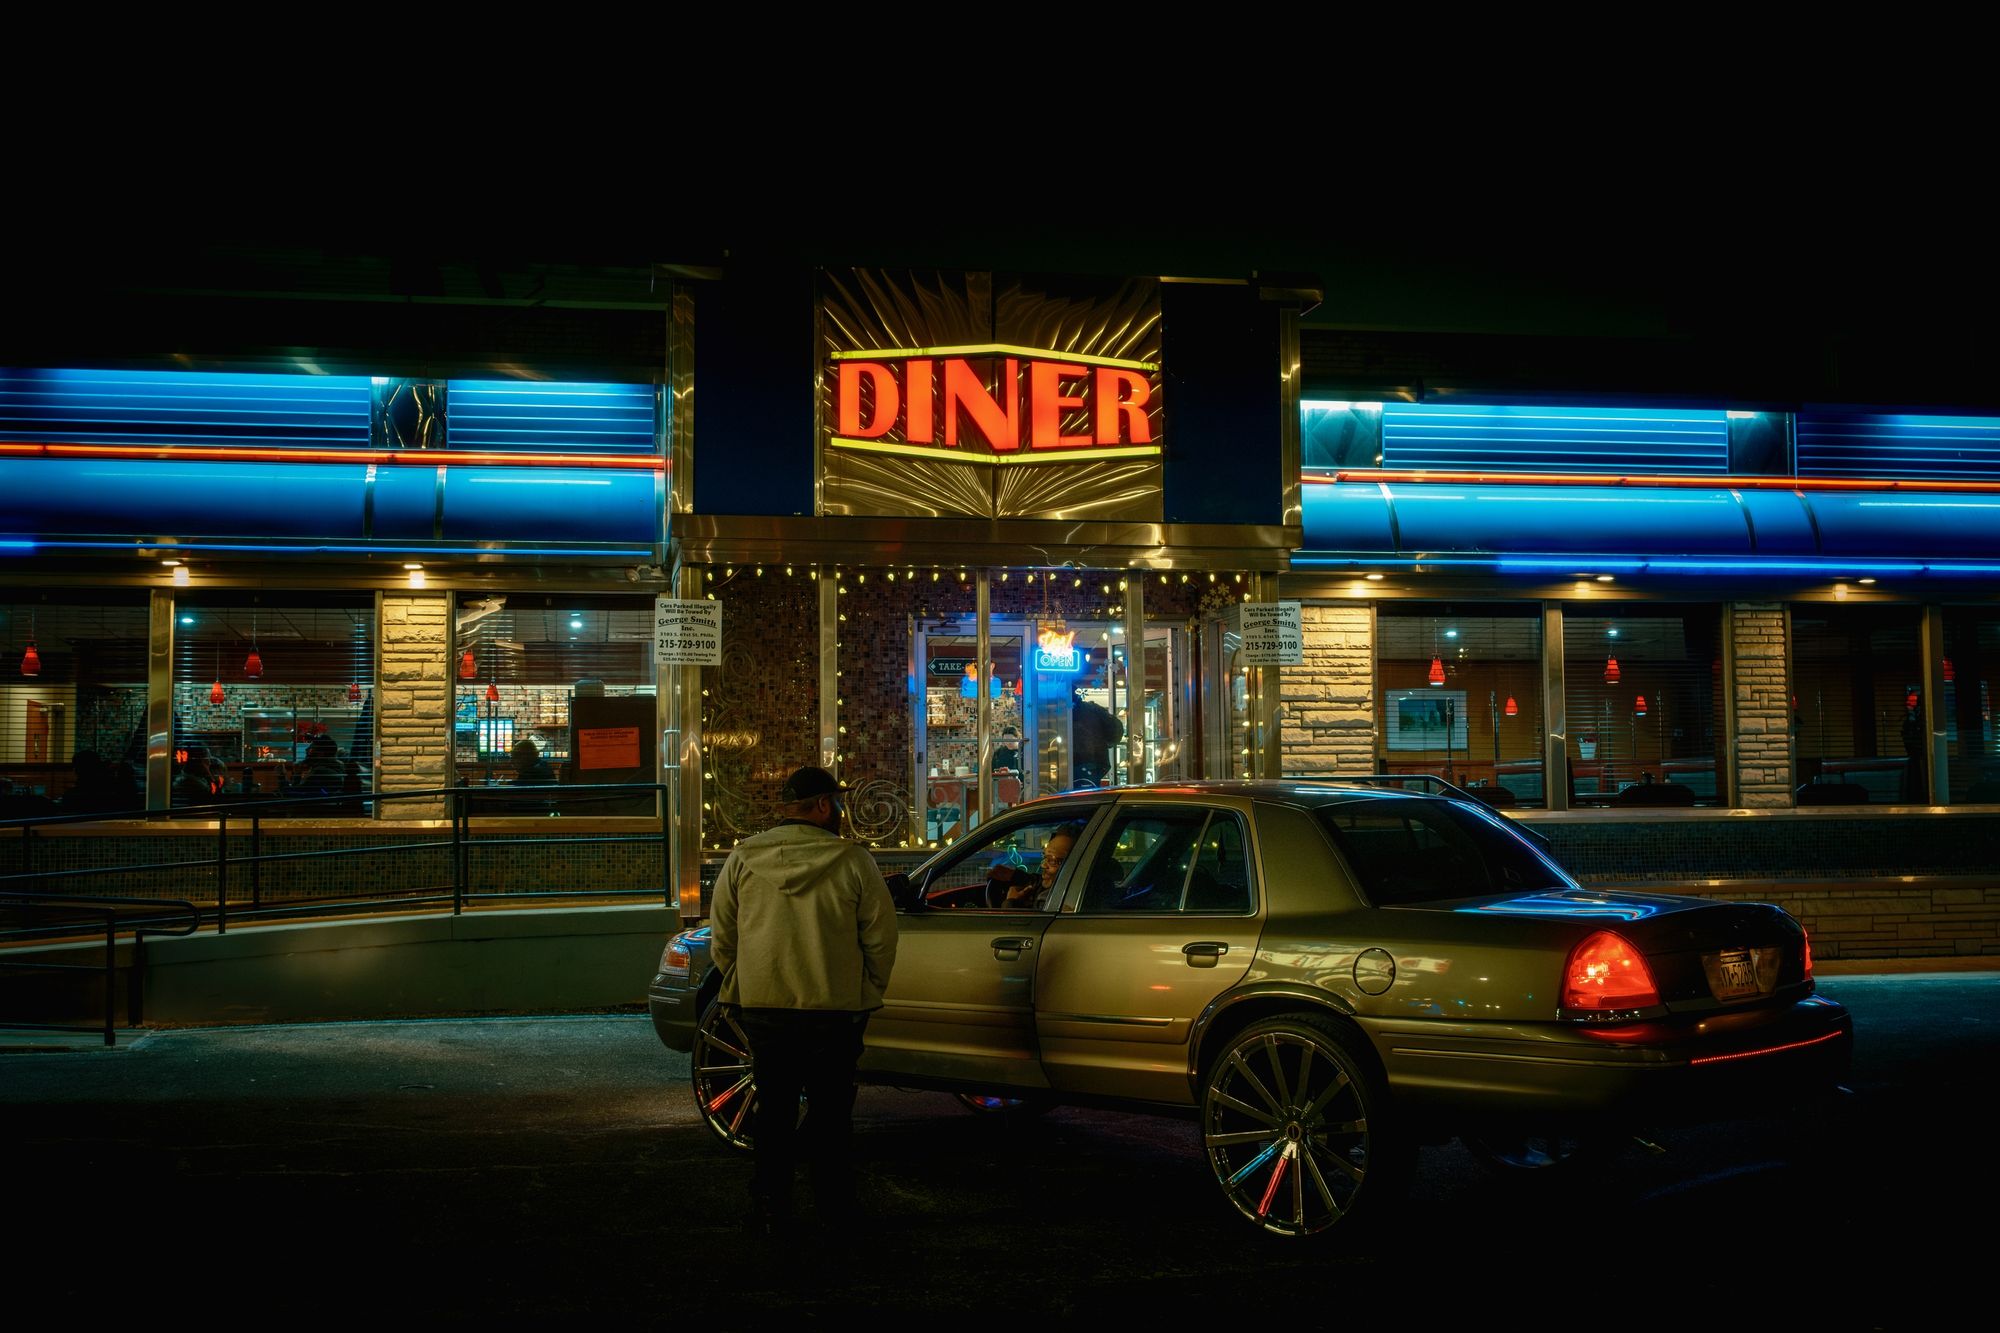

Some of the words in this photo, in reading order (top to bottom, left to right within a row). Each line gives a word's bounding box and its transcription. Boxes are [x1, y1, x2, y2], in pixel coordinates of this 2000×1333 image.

[838, 358, 1152, 450] DINER
[658, 617, 688, 625] George
[690, 616, 716, 626] Smith
[1244, 620, 1270, 629] George
[1272, 619, 1296, 628] Smith
[659, 640, 716, 649] 215-729-9100
[1246, 641, 1297, 650] 215-729-9100
[1040, 654, 1074, 666] OPEN
